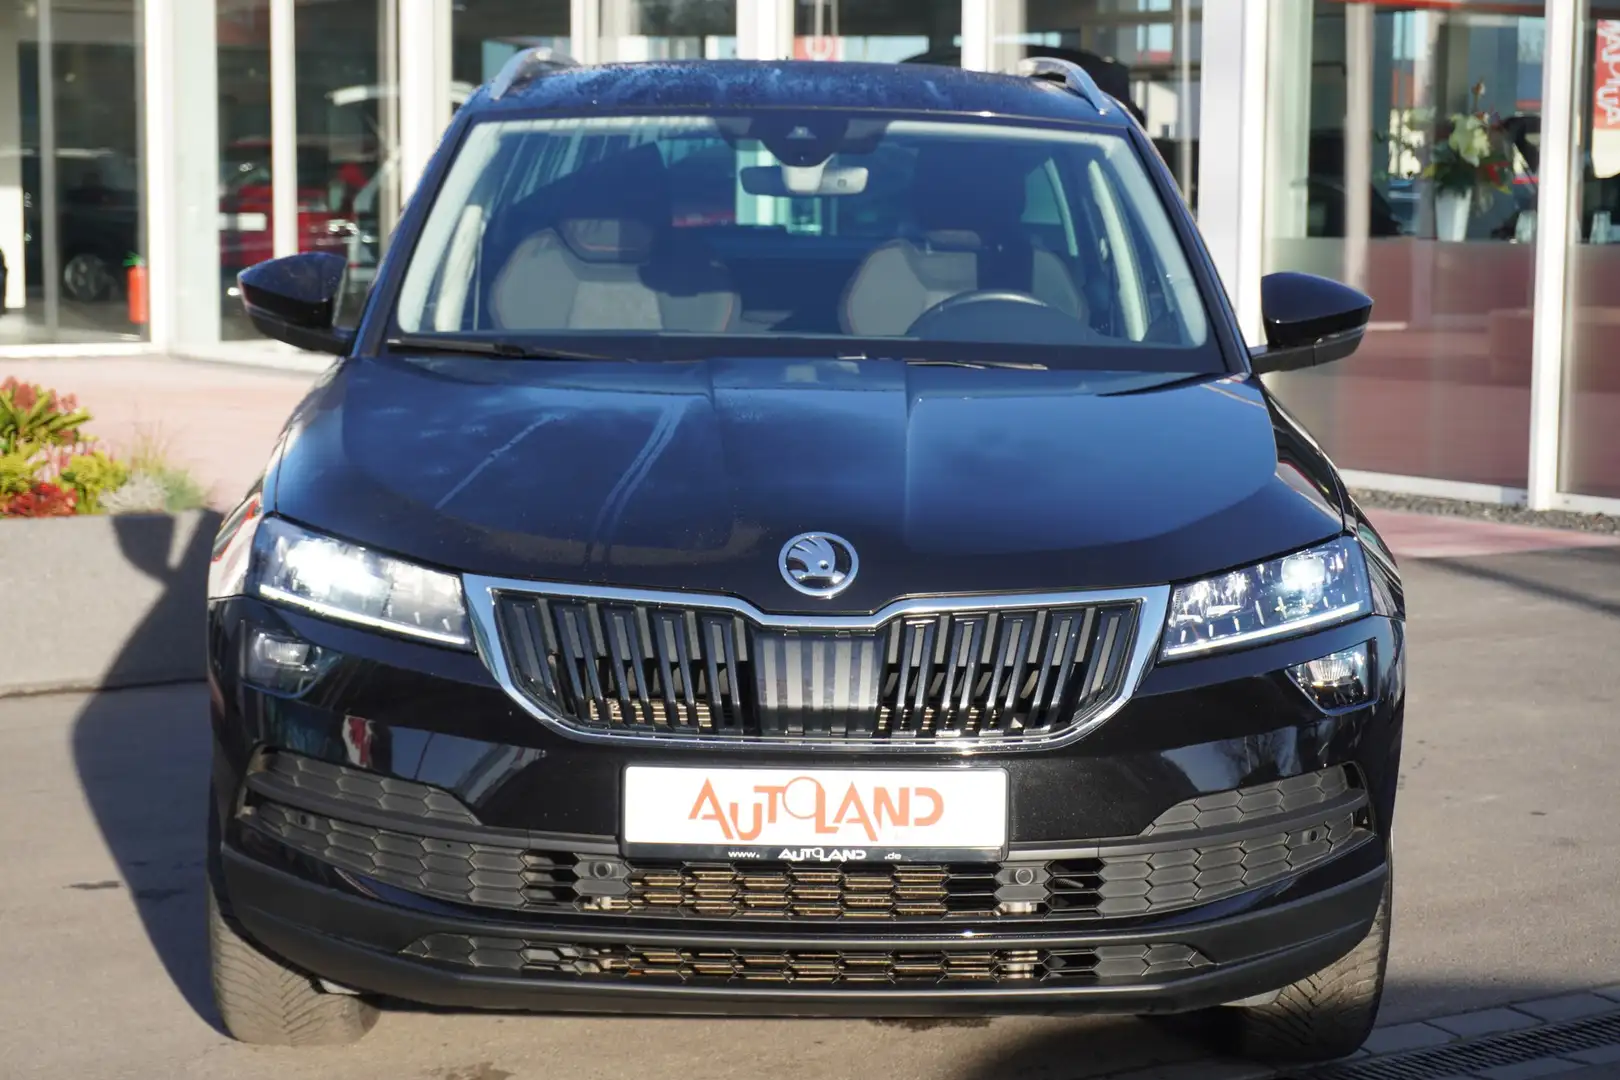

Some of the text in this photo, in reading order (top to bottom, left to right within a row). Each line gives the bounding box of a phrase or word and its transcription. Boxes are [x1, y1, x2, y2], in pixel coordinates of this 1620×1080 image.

[689, 775, 944, 841] AUTOLAND
[778, 847, 867, 862] AUTOLAND
[884, 851, 902, 860] .de
